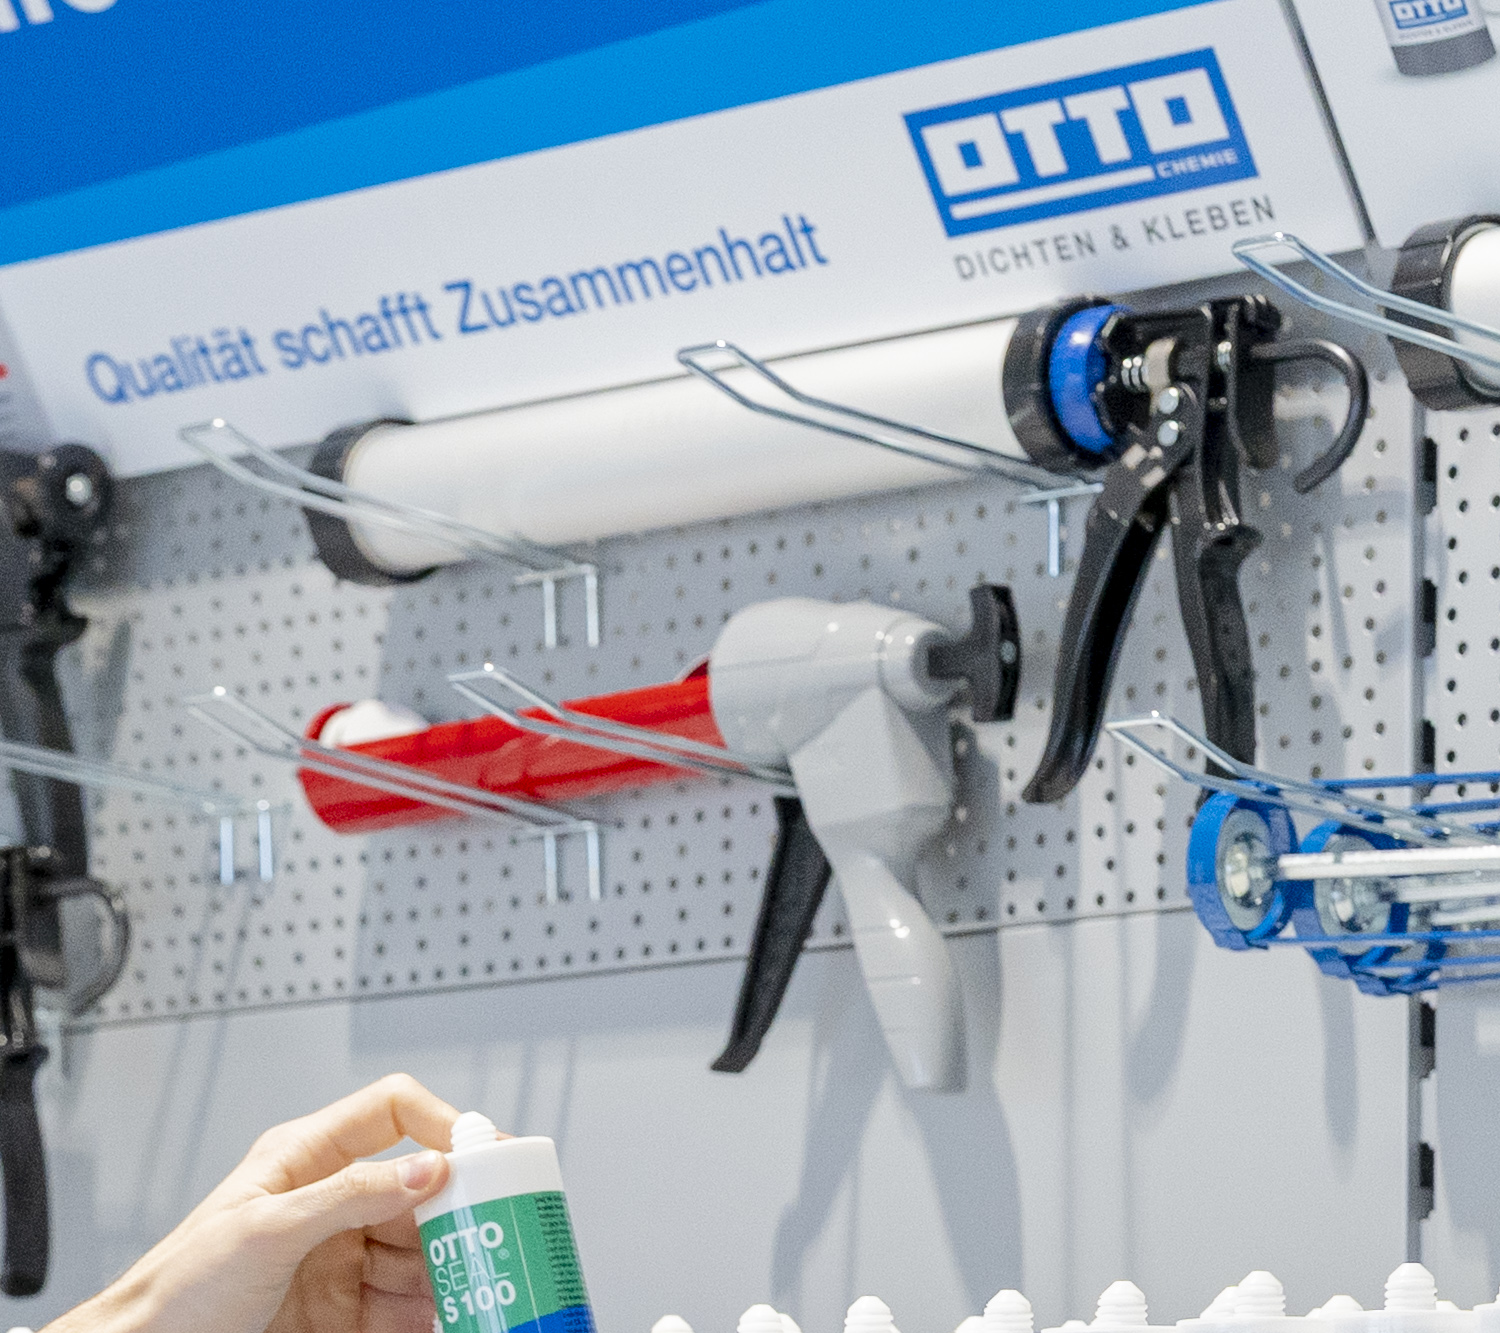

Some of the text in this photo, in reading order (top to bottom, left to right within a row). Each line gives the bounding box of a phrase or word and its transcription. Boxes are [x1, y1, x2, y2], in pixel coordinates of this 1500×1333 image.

[920, 67, 1230, 197] OTTO
[1156, 148, 1238, 178] CHEMIE
[954, 194, 1276, 280] DICHTEN & KLEBEN
[84, 214, 829, 404] Qualität schafft Zusammenhalt
[429, 1220, 504, 1267] OTTO
[445, 1279, 517, 1325] S 100
